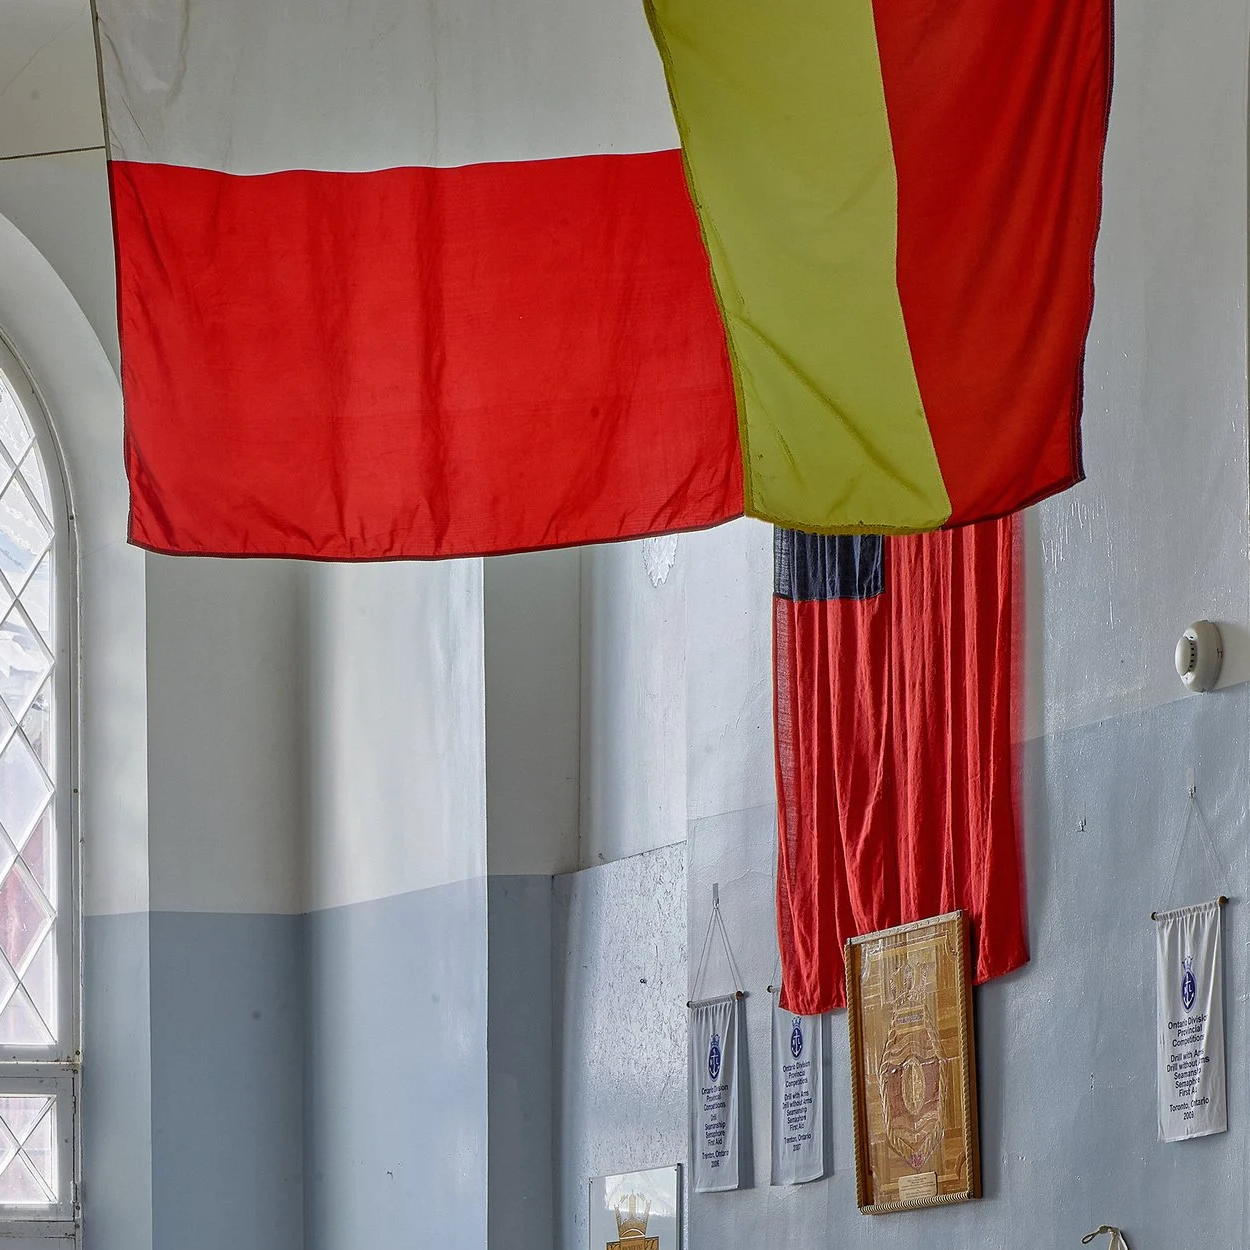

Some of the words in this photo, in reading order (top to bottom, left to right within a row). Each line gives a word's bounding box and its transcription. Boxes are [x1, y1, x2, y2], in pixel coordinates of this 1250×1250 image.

[1188, 1014, 1207, 1025] Divisio
[1178, 1024, 1202, 1037] Provincial
[1173, 1035, 1204, 1047] Competition
[1171, 1053, 1182, 1062] Drill
[1167, 1063, 1178, 1072] Drill
[1179, 1060, 1198, 1070] without
[1174, 1068, 1202, 1080] Seamansp
[1175, 1077, 1200, 1089] Semaphe
[1179, 1089, 1190, 1097] First
